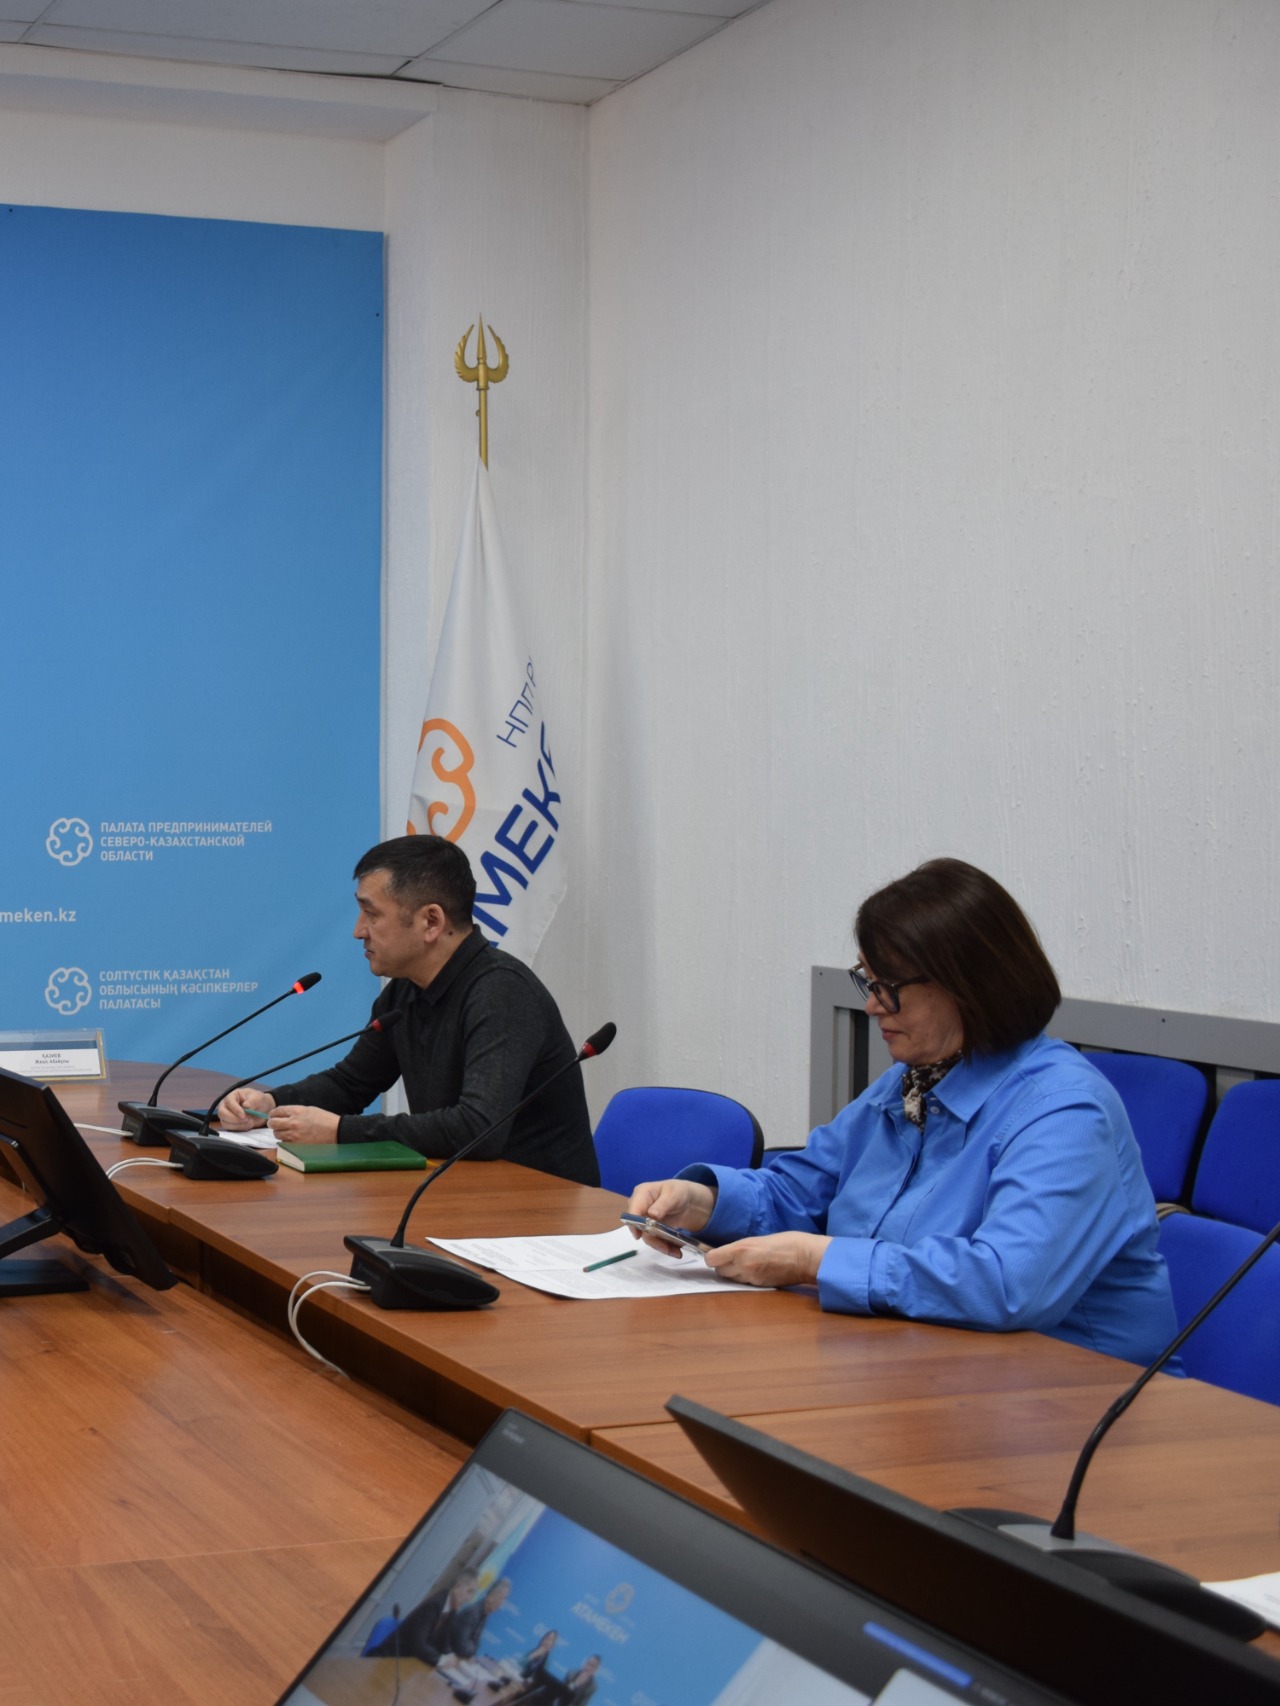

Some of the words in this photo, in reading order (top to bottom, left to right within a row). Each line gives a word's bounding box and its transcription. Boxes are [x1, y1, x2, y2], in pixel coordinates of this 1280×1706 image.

[100, 822, 146, 833] ПАЛАТА
[148, 819, 273, 834] ПРЕДПРИНИМАТЕЛЕЙ
[100, 834, 246, 847] СЕВЕРО-КАЗАХСТАНСКОЙ
[100, 850, 154, 862] ОБЛАСТИ
[99, 998, 161, 1010] ПАЛАТАСЫ
